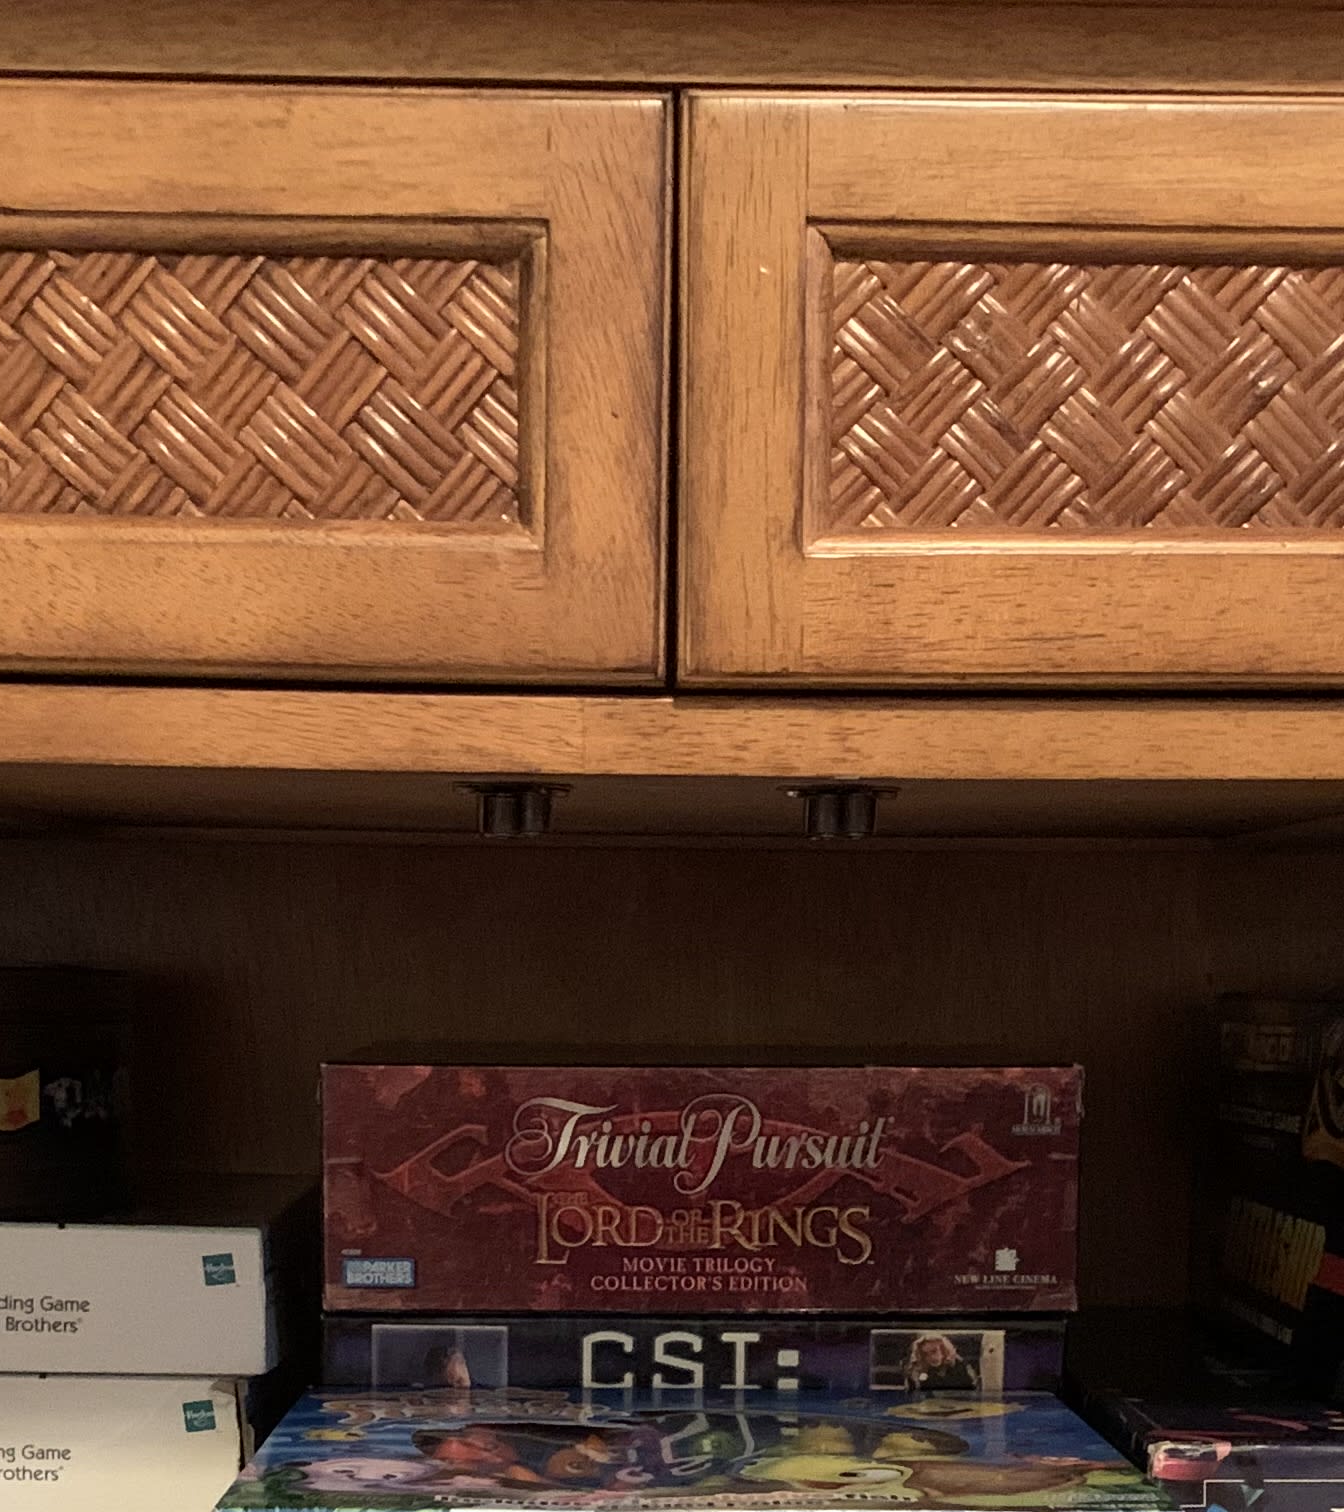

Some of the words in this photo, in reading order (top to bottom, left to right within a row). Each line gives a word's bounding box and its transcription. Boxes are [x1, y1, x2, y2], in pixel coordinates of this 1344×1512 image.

[505, 1096, 693, 1176] Trivial
[674, 1093, 886, 1196] Pursuit
[533, 1192, 664, 1265] LORD
[708, 1198, 875, 1266] RINGS
[622, 1257, 687, 1273] MOVIE
[692, 1257, 776, 1273] TRILOGY
[590, 1275, 724, 1292] COLLECTOR'S
[729, 1275, 808, 1292] EDITION
[39, 1295, 91, 1313] Game
[5, 1316, 78, 1334] Brothers
[582, 1331, 801, 1392] CSI:
[21, 1445, 72, 1461] Game
